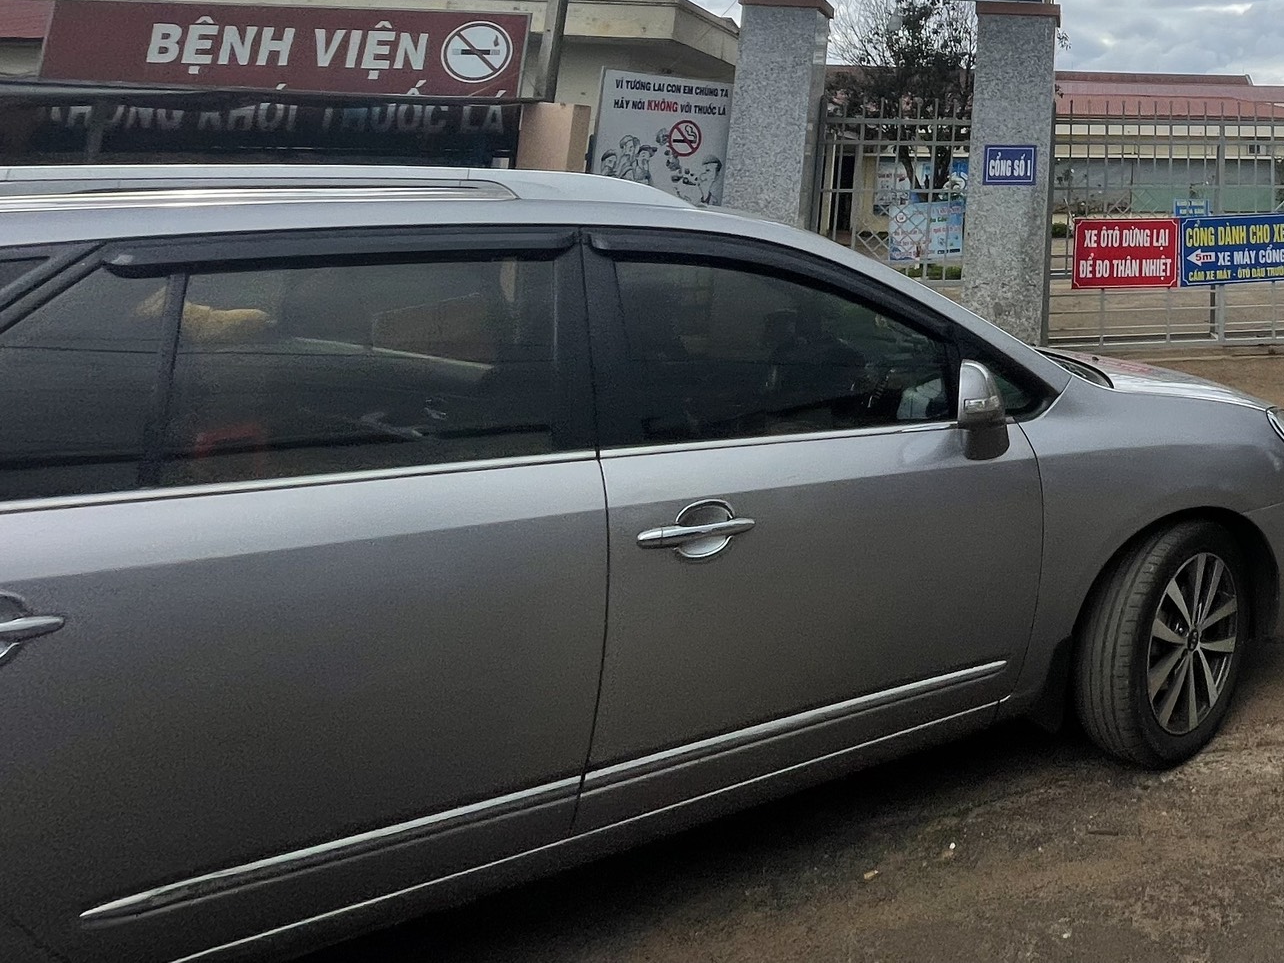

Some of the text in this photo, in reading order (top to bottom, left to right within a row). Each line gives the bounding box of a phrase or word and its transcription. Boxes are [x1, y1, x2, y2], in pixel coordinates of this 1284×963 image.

[145, 15, 429, 80] BỆNH VIỆN
[653, 83, 665, 93] LAI
[666, 83, 681, 94] CON
[683, 85, 693, 95] EM
[720, 89, 729, 98] TA
[646, 98, 678, 113] KHÔNG
[989, 151, 1011, 177] CỔNG
[1014, 153, 1026, 177] SỐ
[1083, 225, 1170, 251] XE ÔTÔ DỪNG LẠI
[1185, 219, 1216, 248] CỔNG
[1217, 222, 1247, 246] DÀNH
[1249, 224, 1271, 244] CHO
[1079, 252, 1172, 281] ĐỂ ĐO THÂN NHIỆT
[1195, 252, 1212, 262] 5m
[1217, 251, 1231, 266] XE
[1233, 248, 1257, 265] MÁY
[1206, 270, 1215, 281] XE
